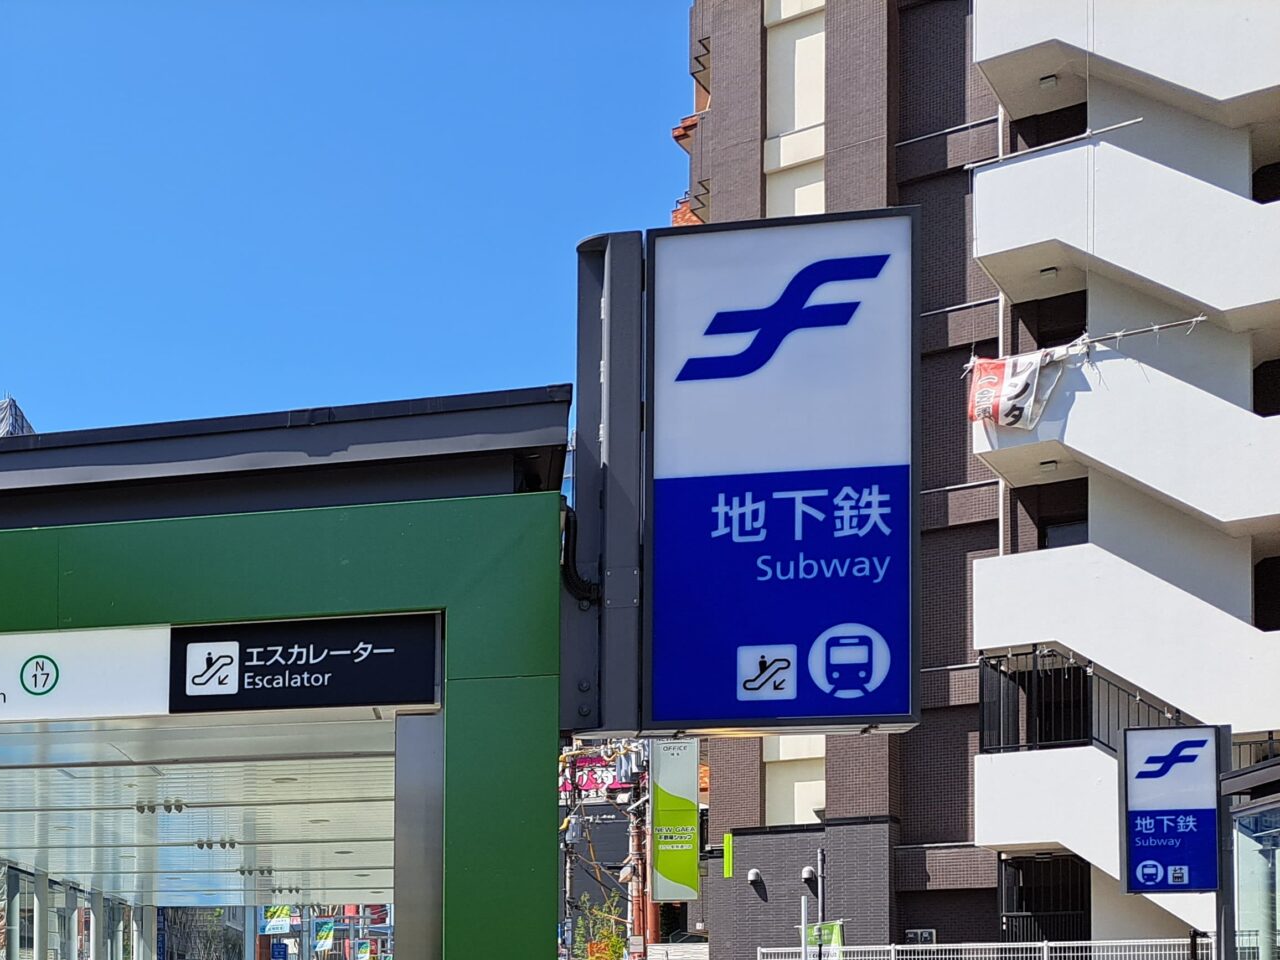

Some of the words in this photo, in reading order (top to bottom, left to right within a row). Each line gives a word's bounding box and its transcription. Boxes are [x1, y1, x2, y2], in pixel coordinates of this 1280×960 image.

[711, 485, 892, 543] 地下鉄
[756, 552, 891, 583] Subway
[245, 642, 395, 666] エスカレーター
[35, 661, 45, 672] N
[31, 673, 50, 689] 17
[244, 671, 332, 689] Escalator
[1135, 815, 1198, 834] 地下鉄
[1135, 837, 1181, 848] Subway
